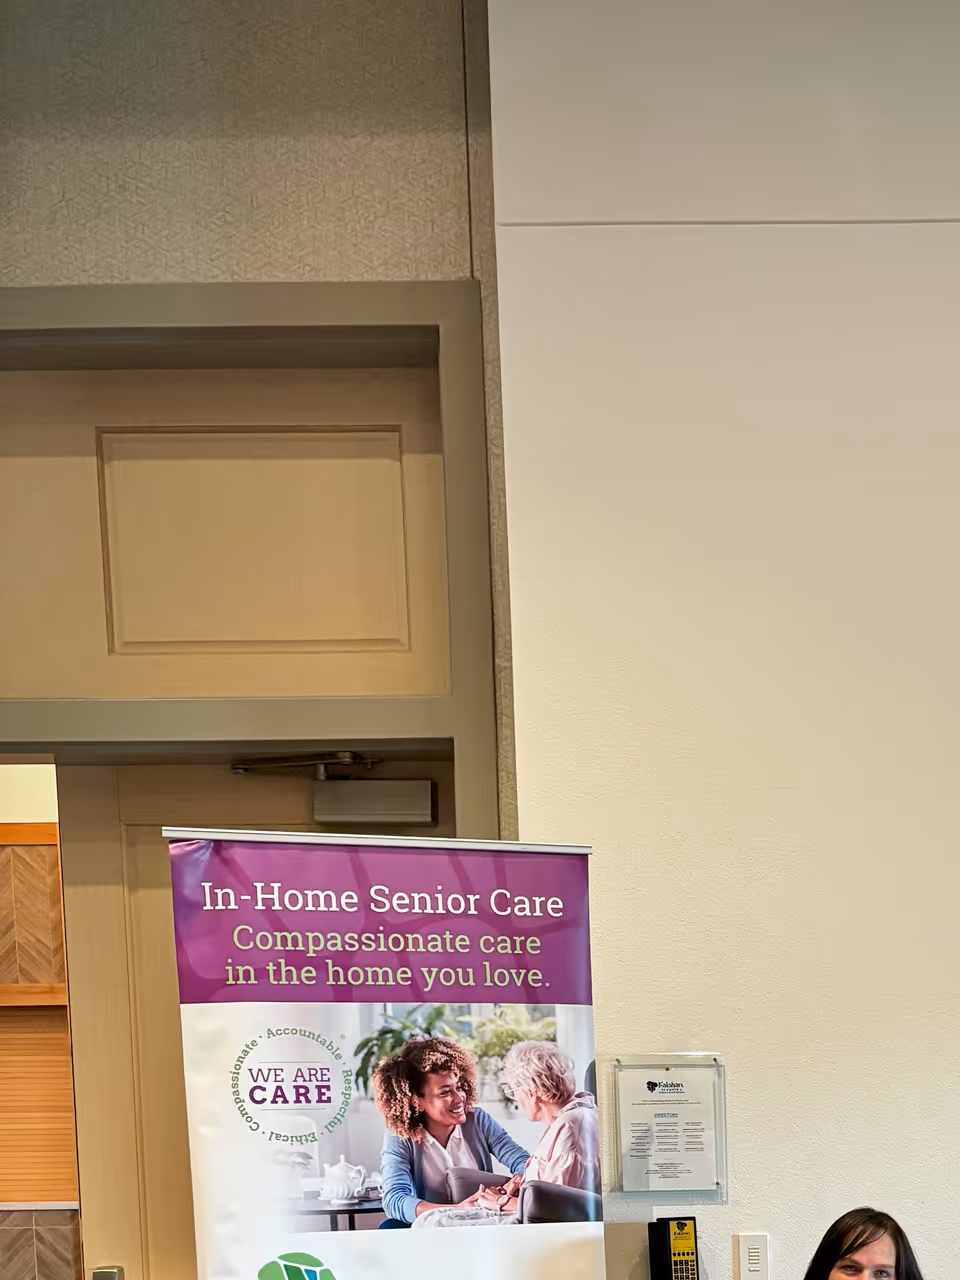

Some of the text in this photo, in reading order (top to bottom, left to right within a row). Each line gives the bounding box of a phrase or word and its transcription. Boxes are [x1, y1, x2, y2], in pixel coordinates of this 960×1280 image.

[201, 882, 564, 917] In-Home Senior Care
[233, 924, 541, 957] Compassionate care
[225, 959, 550, 992] in the home you love.
[230, 1027, 353, 1145] Compassionate Accountable Respectful Ethical
[248, 1068, 331, 1083] WE ARE
[249, 1085, 331, 1105] CARE
